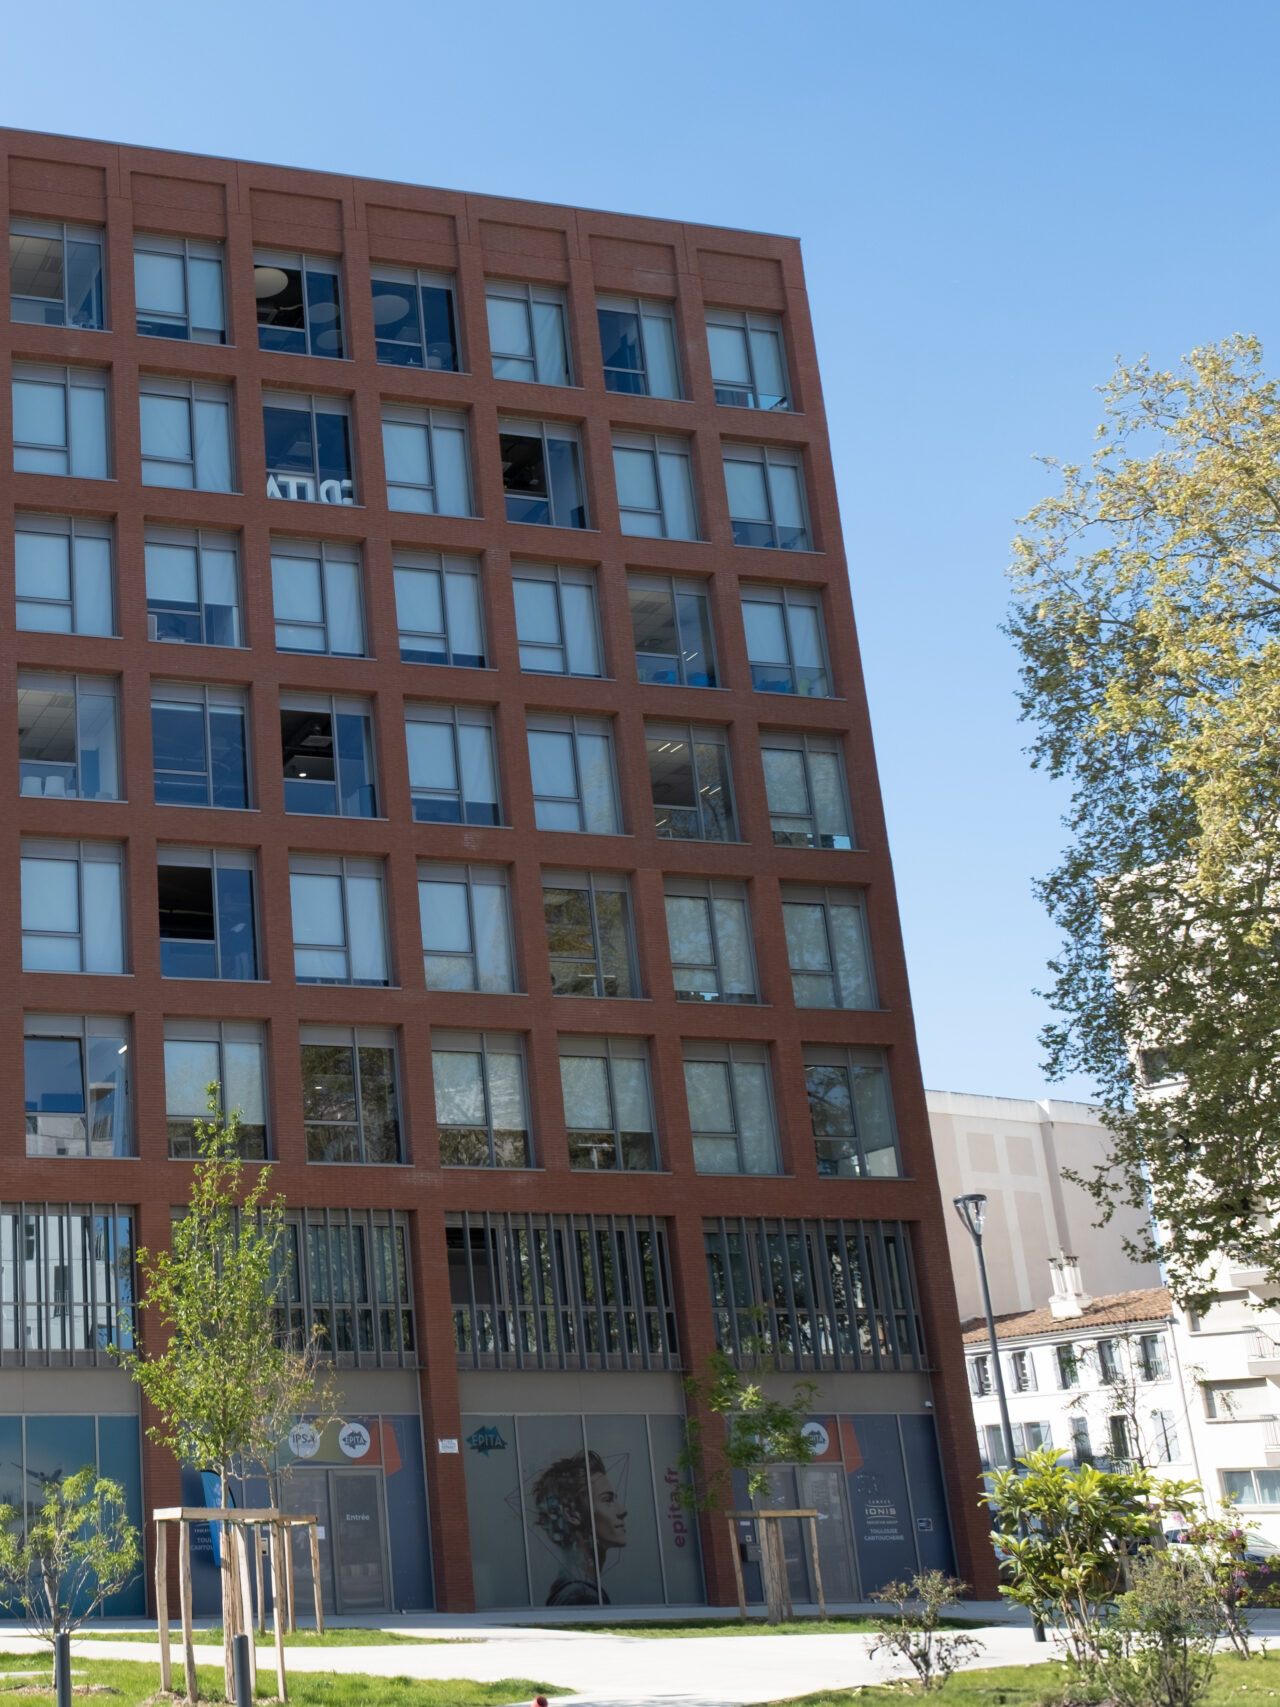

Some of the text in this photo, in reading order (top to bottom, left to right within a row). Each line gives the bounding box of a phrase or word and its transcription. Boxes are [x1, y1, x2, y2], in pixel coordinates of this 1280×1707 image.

[345, 1435, 365, 1443] EPITA
[472, 1434, 502, 1446] EPITA
[664, 1467, 688, 1547] epitafr
[346, 1513, 370, 1521] Entrée
